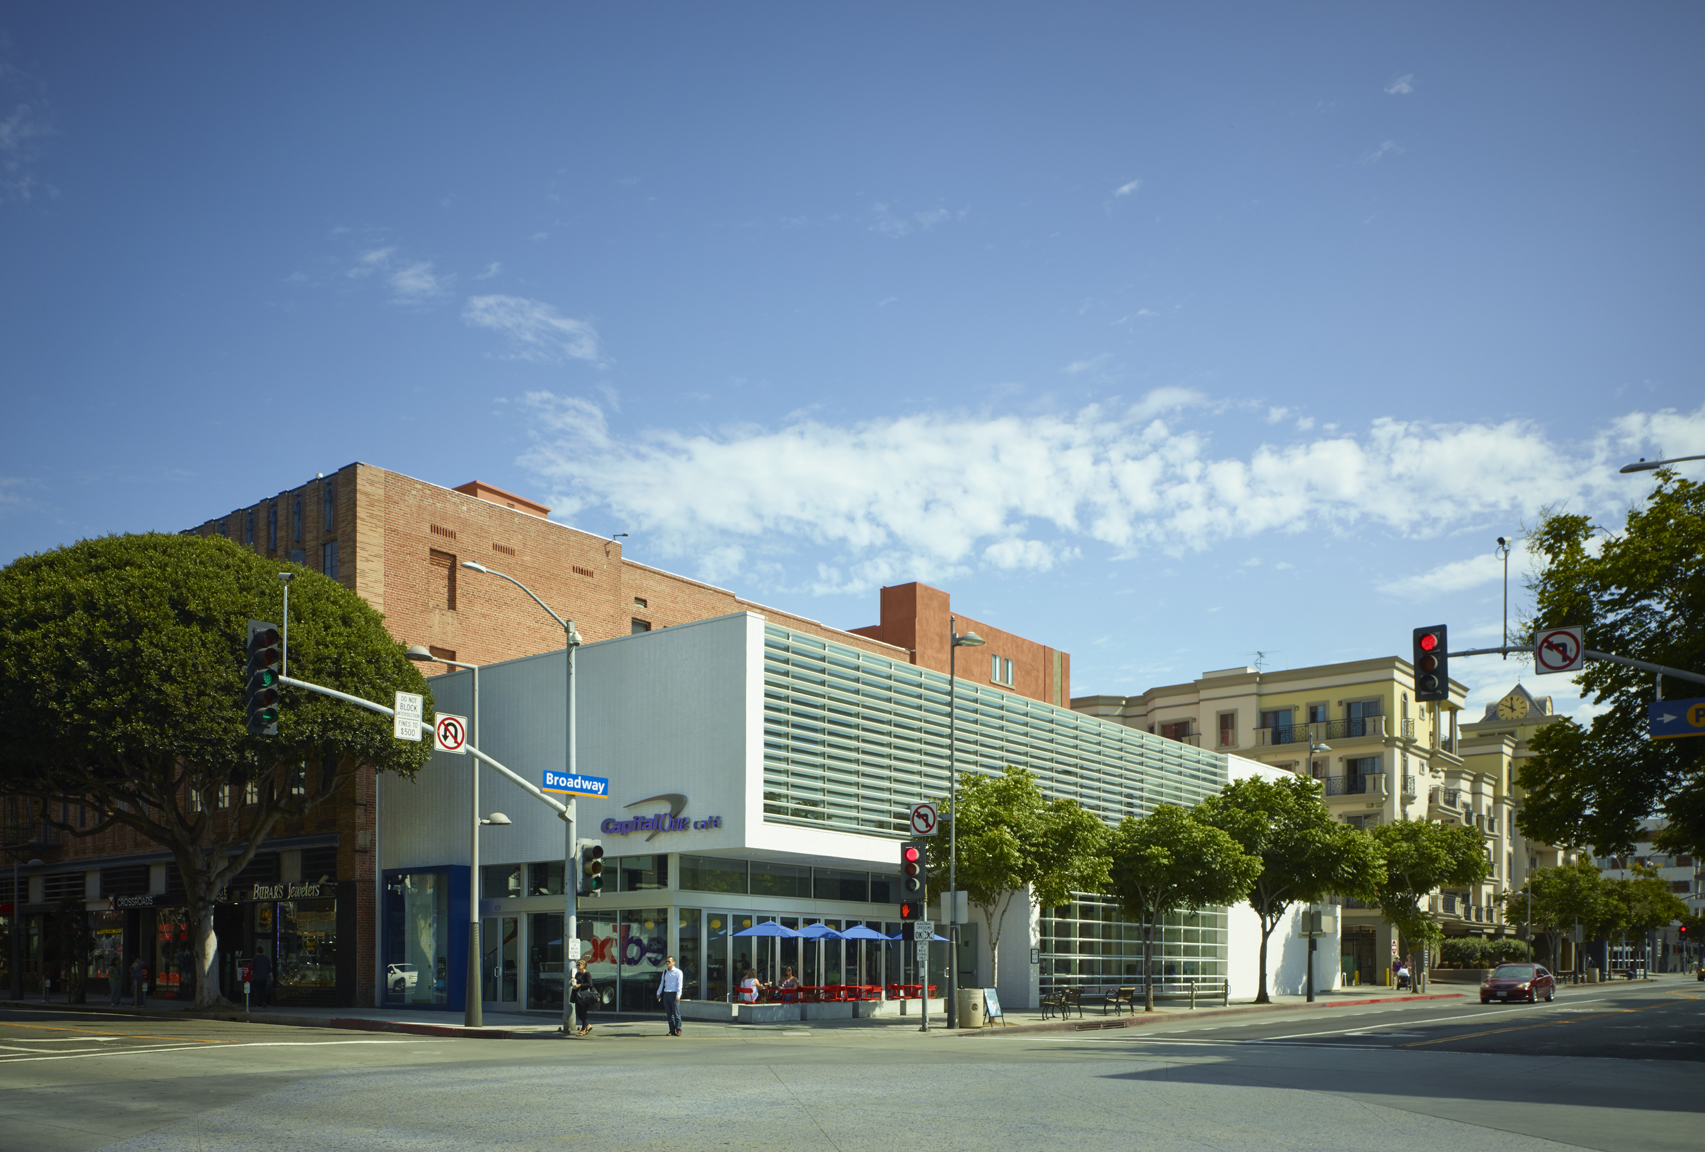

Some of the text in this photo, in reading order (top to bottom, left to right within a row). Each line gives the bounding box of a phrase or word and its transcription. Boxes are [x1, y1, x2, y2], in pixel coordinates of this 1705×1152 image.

[400, 702, 418, 712] BLOCK
[398, 719, 419, 729] FINES TO
[400, 727, 416, 737] $500
[546, 772, 606, 795] Broadway
[287, 881, 321, 899] Jewelers
[117, 896, 154, 907] CROSSROADS
[915, 931, 923, 939] OK
